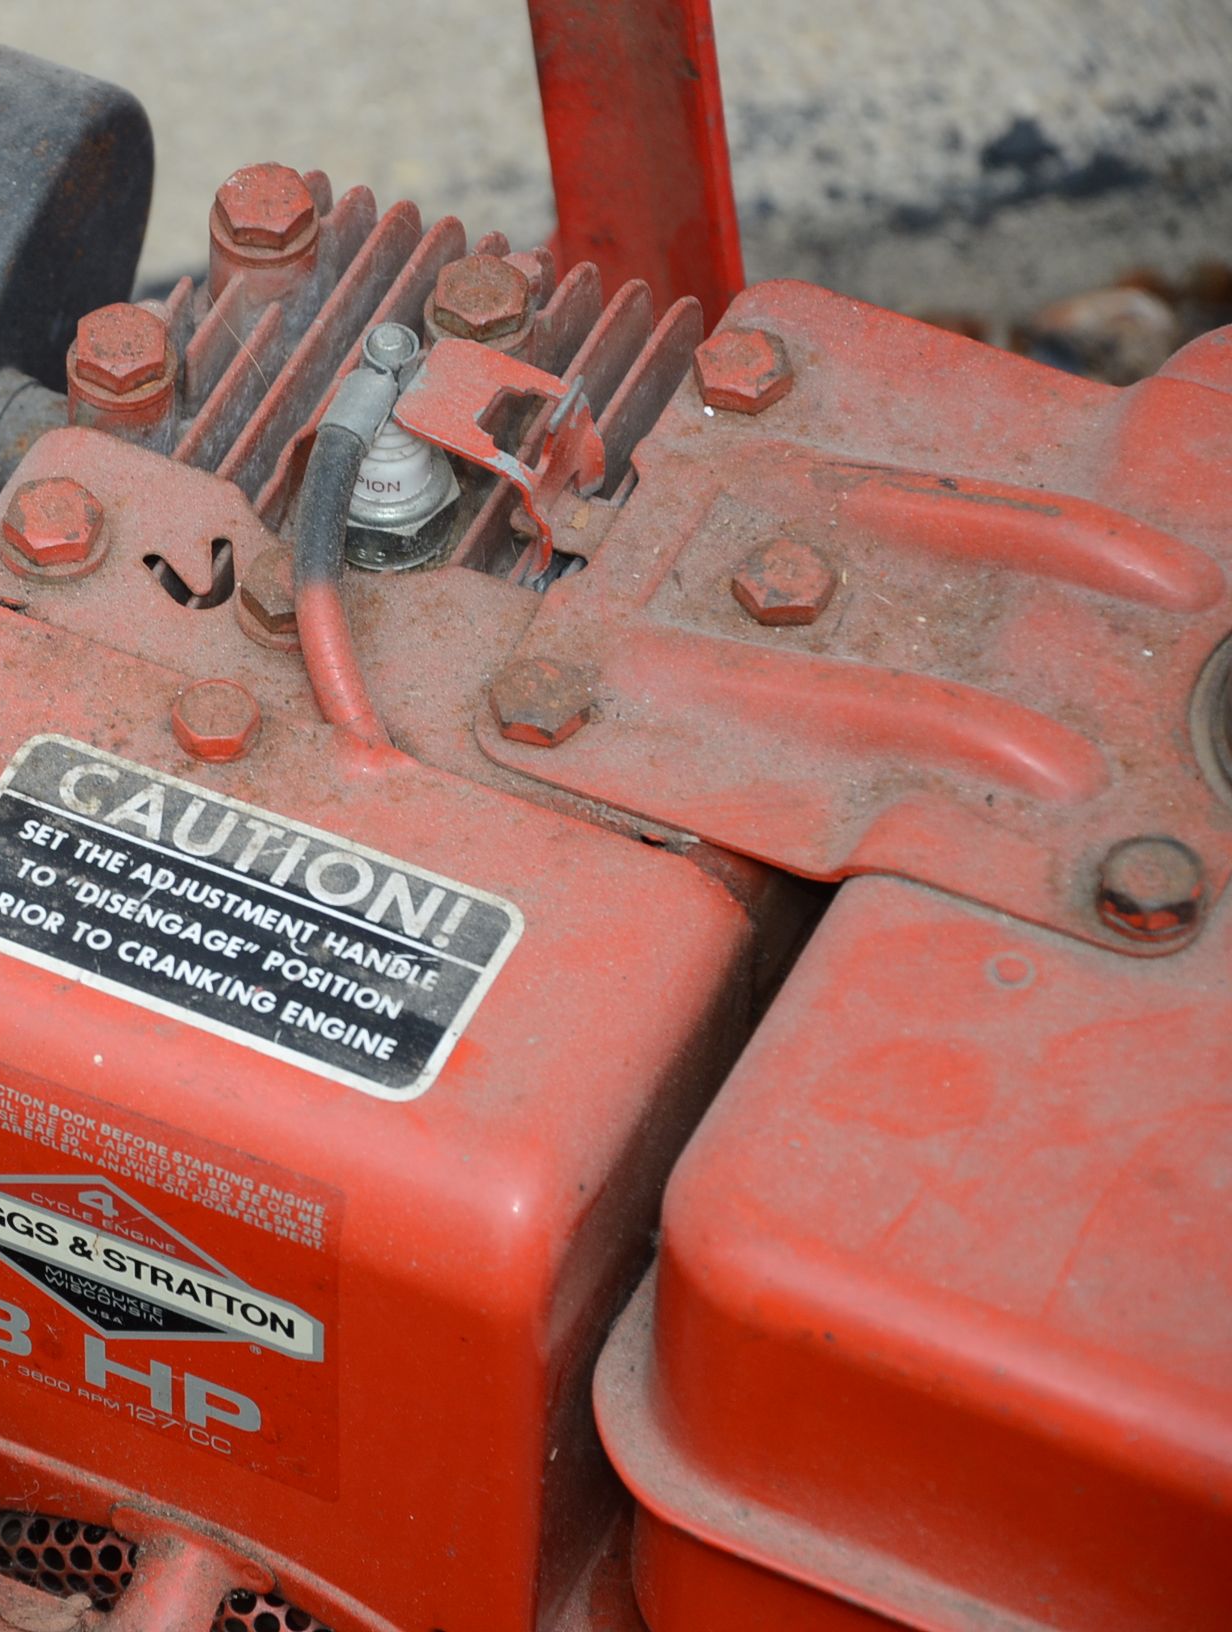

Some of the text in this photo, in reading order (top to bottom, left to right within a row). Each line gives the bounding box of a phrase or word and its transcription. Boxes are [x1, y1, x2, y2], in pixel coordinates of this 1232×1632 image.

[59, 760, 473, 949] CAUTION!
[16, 858, 59, 889] TO
[261, 950, 405, 1020] POSITION
[17, 818, 441, 992] SET THE ADJUSTMENT HANDLE
[70, 921, 115, 953] TO
[116, 939, 280, 1015] CRANKING
[280, 1000, 399, 1061] ENGINE
[25, 1119, 53, 1140] SAE
[105, 1149, 118, 1164] IN
[199, 1185, 229, 1206] USE
[26, 1108, 56, 1129] USE
[64, 1122, 88, 1142] OIL
[97, 1134, 169, 1172] LABELED
[241, 1188, 259, 1206] SE
[269, 1199, 290, 1218] OR
[51, 1104, 94, 1132] BOOK
[102, 1123, 166, 1159] BEFORE
[174, 1151, 252, 1191] STARTING
[98, 1158, 130, 1179] AND
[194, 1194, 238, 1220] FOAM
[32, 1191, 175, 1256] CYCLE ENGINE
[77, 1190, 119, 1219] 4
[45, 1274, 162, 1327] WISCONSIN
[46, 1266, 162, 1319] MILWAUKEE
[69, 1235, 95, 1261] &
[103, 1247, 295, 1340] STRATTON
[78, 1388, 119, 1412] RPM
[126, 1403, 177, 1434] 127
[190, 1427, 230, 1456] CC
[84, 1336, 261, 1432] HP
